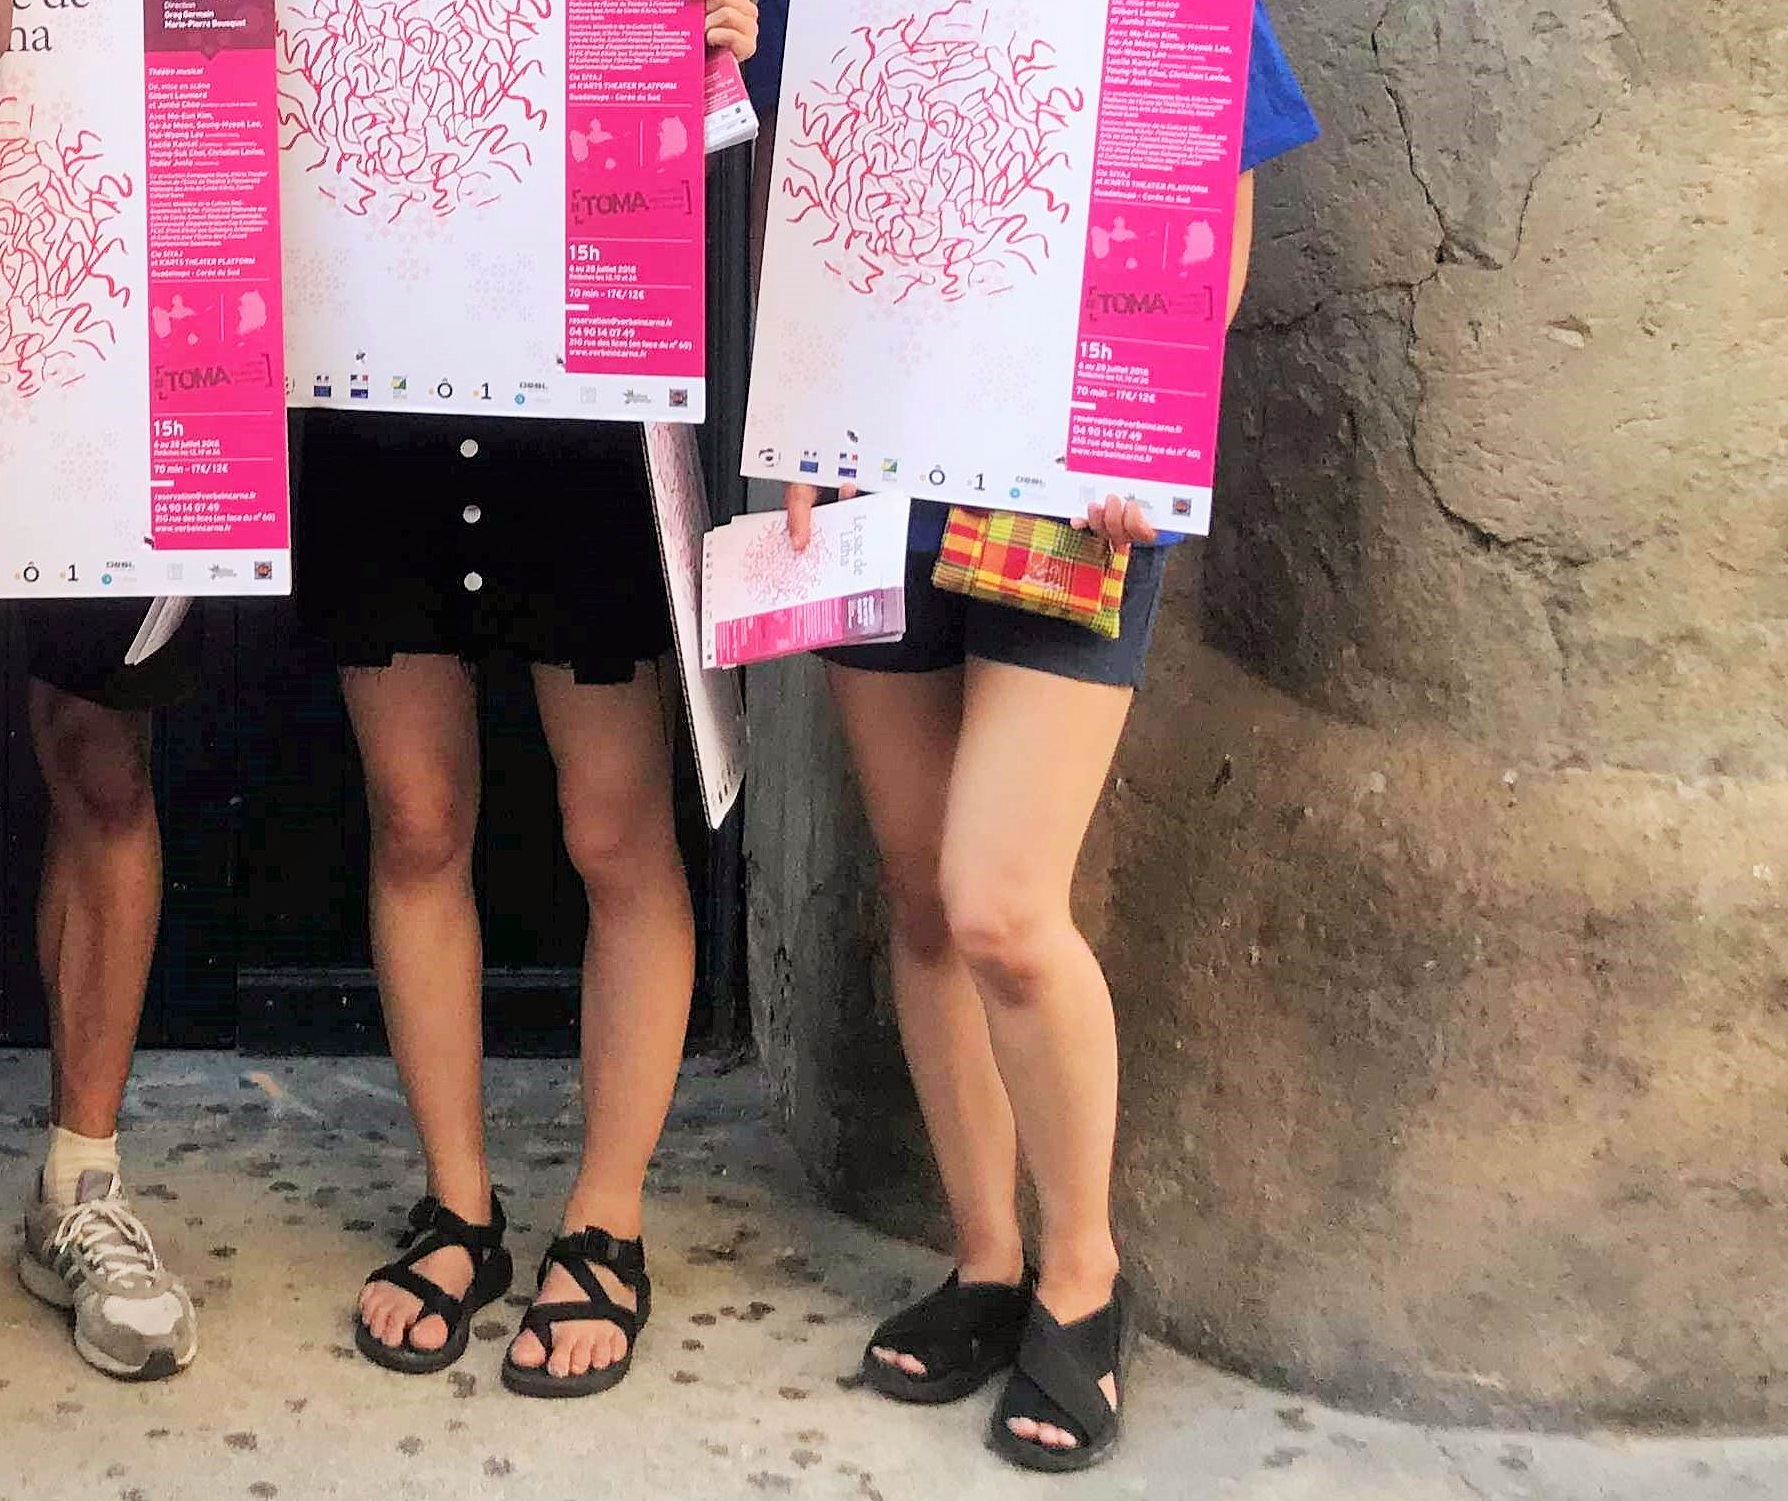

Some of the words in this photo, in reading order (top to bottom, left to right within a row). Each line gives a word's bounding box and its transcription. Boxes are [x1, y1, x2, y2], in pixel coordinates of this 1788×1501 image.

[580, 189, 649, 217] TOMA
[569, 243, 600, 262] 15h
[1095, 286, 1170, 320] TOMA
[1079, 340, 1113, 361] 15h
[164, 364, 231, 392] TOMA
[153, 419, 184, 437] 15h
